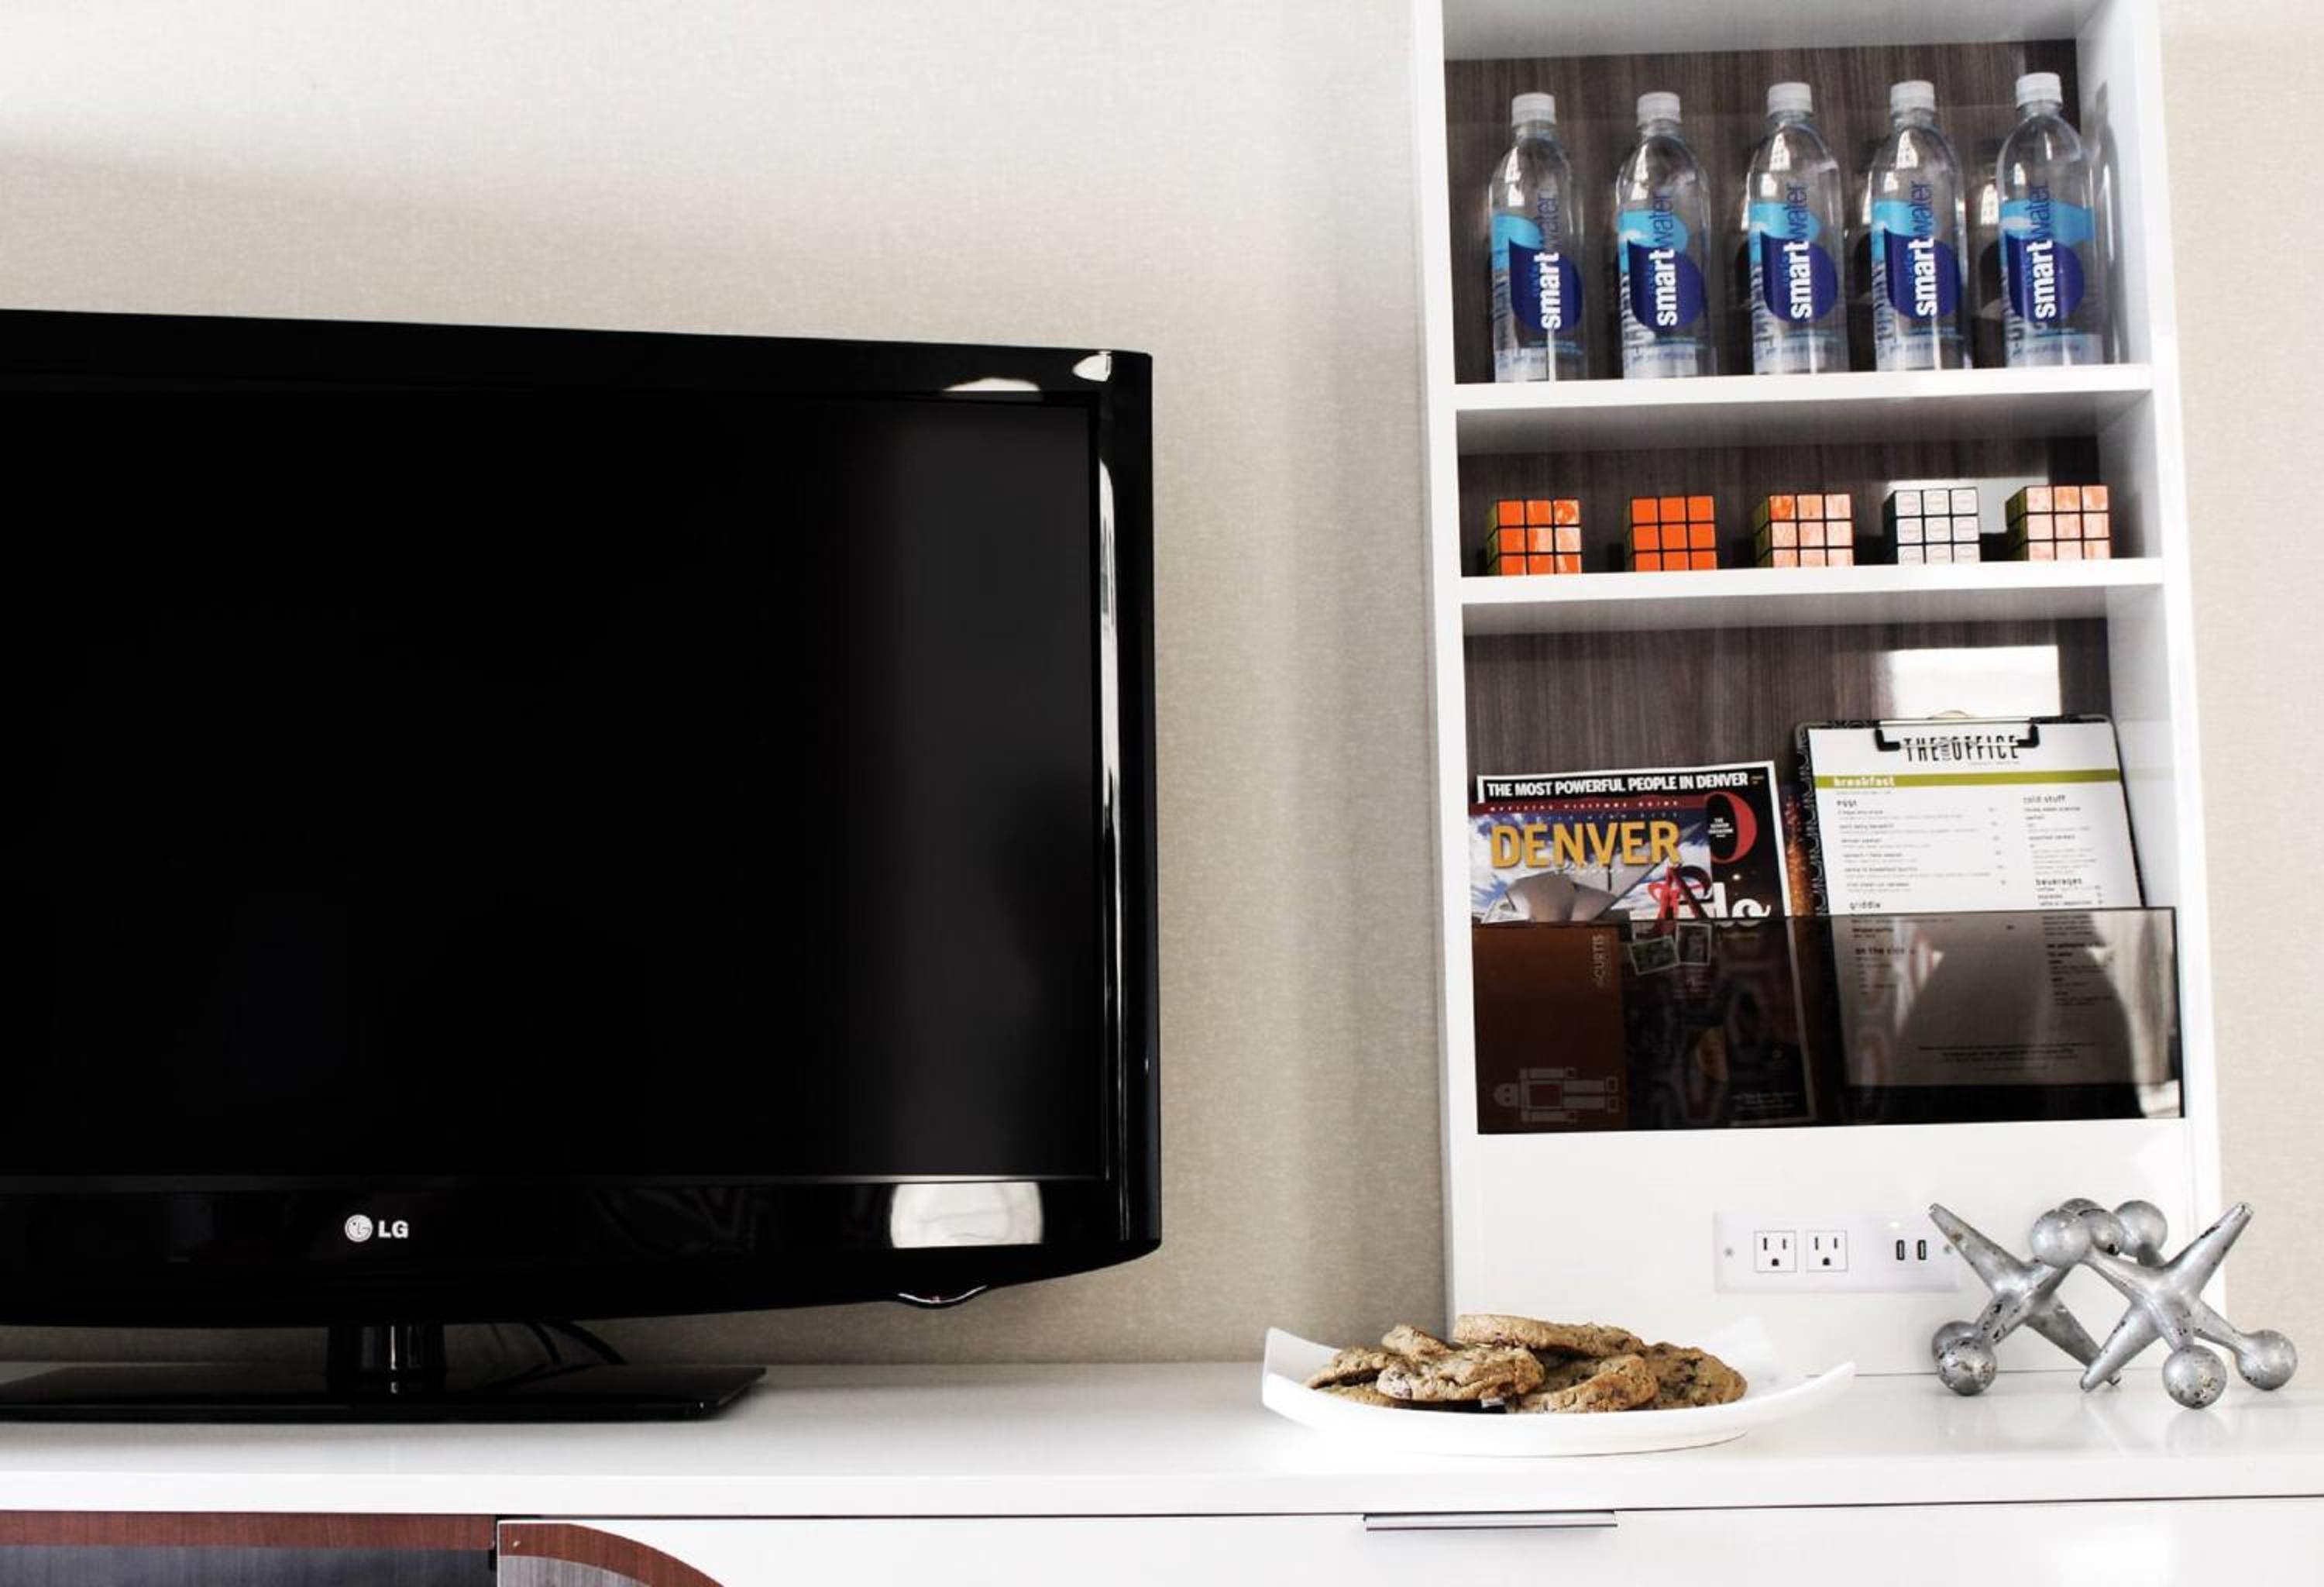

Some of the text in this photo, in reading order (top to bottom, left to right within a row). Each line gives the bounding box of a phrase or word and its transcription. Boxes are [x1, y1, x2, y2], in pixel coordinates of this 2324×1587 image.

[1903, 736, 1939, 762] THE
[1951, 735, 2019, 760] OFFICE
[1487, 781, 1512, 797] THE
[1514, 780, 1552, 796] MOST
[1554, 777, 1626, 795] POWERFUL
[1628, 776, 1679, 792] PEOPLE
[1679, 775, 1694, 790] IN
[1696, 773, 1748, 789] DENVER
[1833, 776, 1896, 787] breakfast
[1490, 820, 1682, 869] DENVER
[377, 1219, 409, 1239] LG
